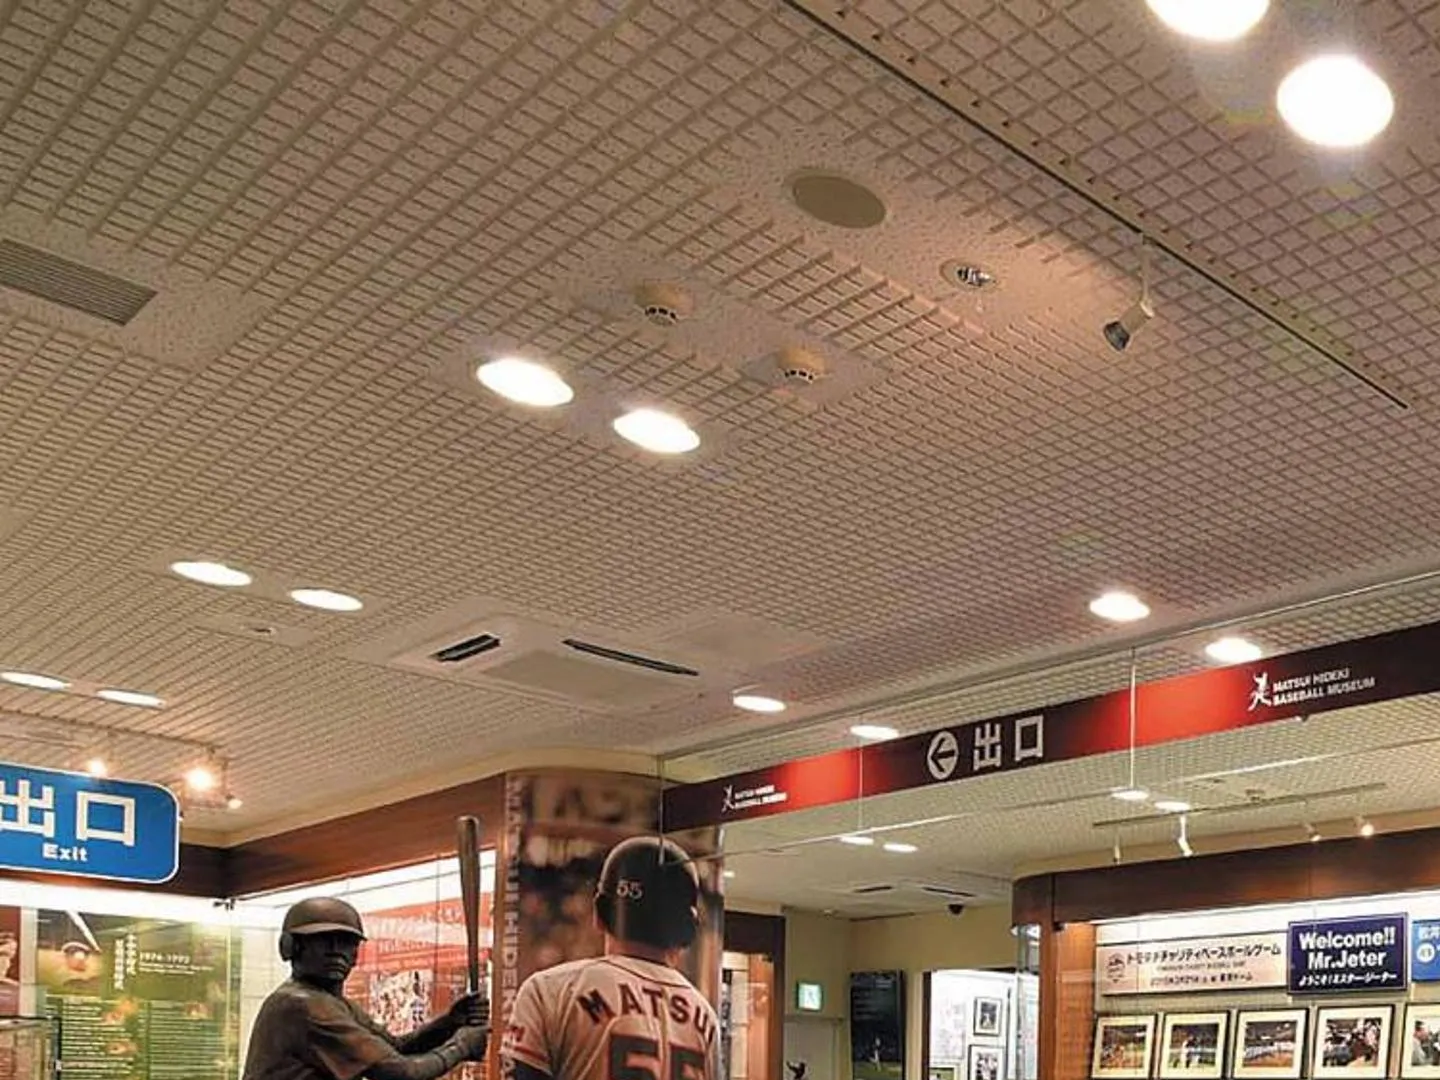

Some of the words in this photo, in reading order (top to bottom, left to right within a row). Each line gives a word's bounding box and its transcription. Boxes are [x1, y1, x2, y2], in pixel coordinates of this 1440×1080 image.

[1273, 675, 1311, 693] MATSUI
[1312, 667, 1350, 685] HIDEKI
[1273, 687, 1325, 706] BASEBALL
[1327, 677, 1376, 696] MUSEUM
[973, 715, 1043, 771] 出口
[0, 779, 135, 847] 出口
[42, 842, 88, 862] Exit
[616, 879, 643, 900] 55
[1299, 926, 1396, 951] Welcome!!
[1308, 950, 1388, 971] Mr.Jeter
[578, 982, 716, 1047] MATSUI
